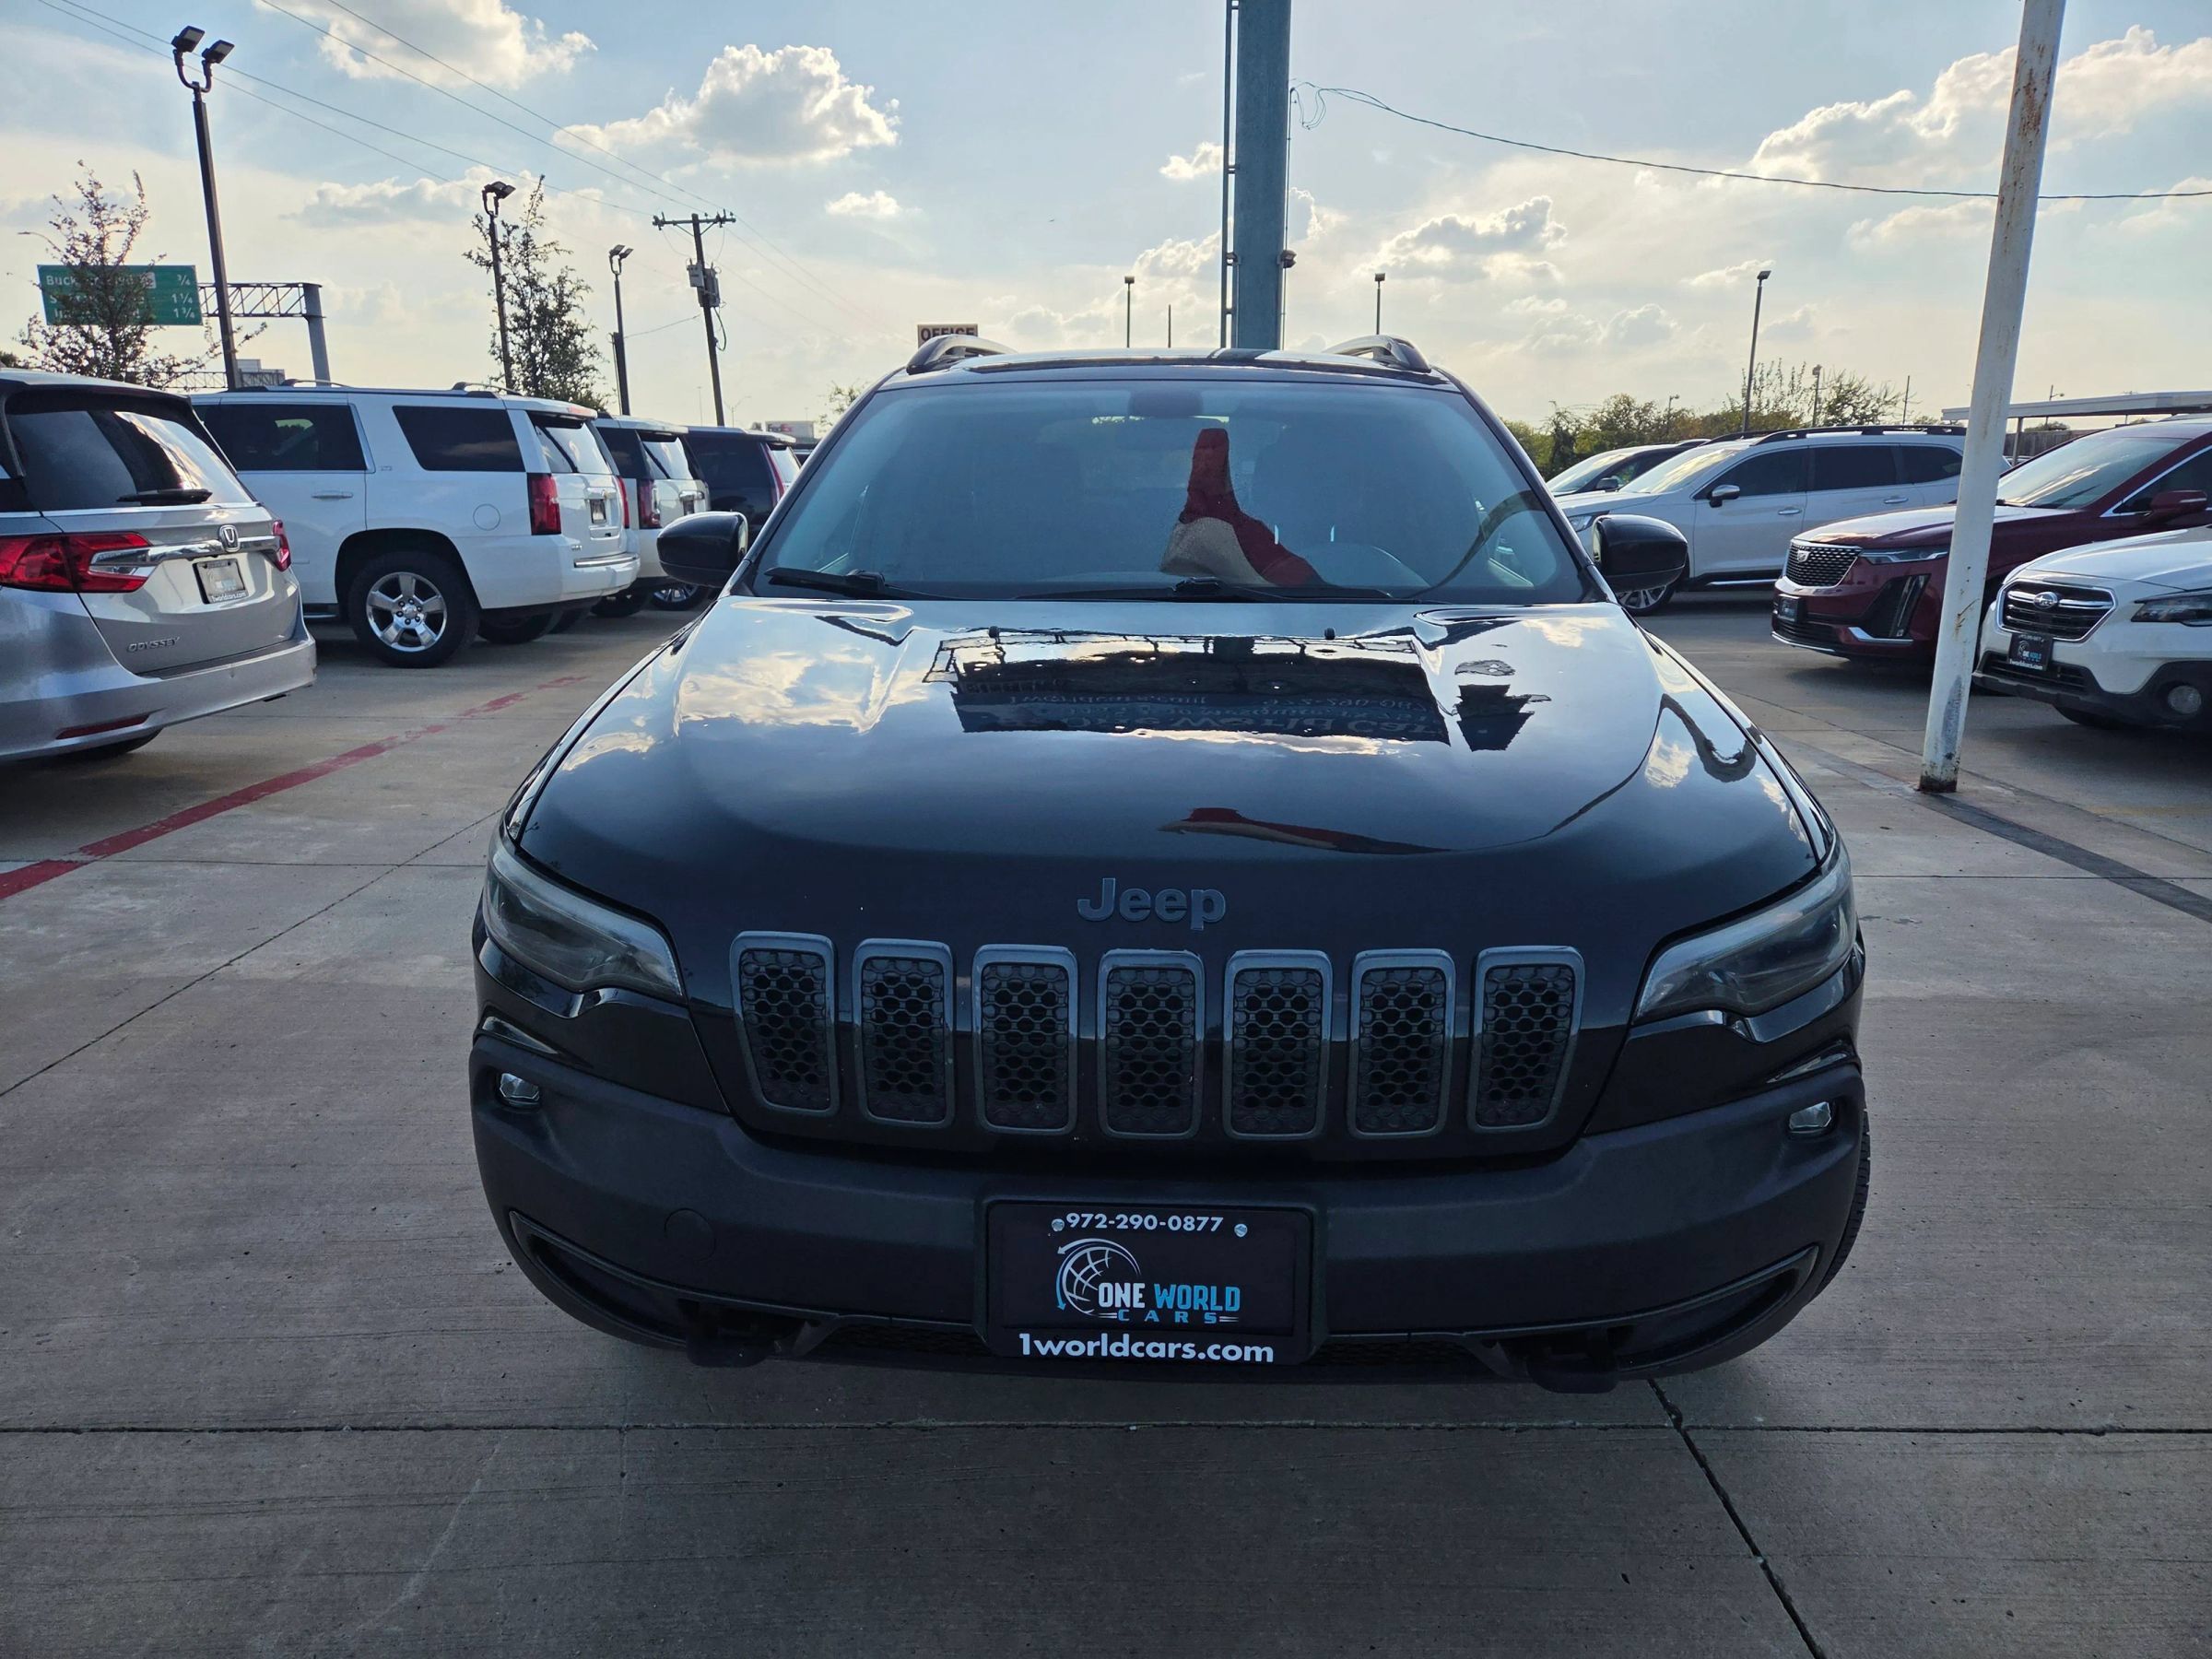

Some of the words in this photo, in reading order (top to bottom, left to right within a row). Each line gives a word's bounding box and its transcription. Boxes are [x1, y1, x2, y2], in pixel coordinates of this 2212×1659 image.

[127, 636, 181, 653] ODYSSEY
[1077, 877, 1227, 931] Jeep
[1066, 1213, 1224, 1232] 972-290-0877
[1098, 1282, 1146, 1309] ONE
[1154, 1283, 1241, 1312] WORLD
[1118, 1309, 1218, 1324] CARS
[1018, 1333, 1274, 1363] 1worldcars.com
